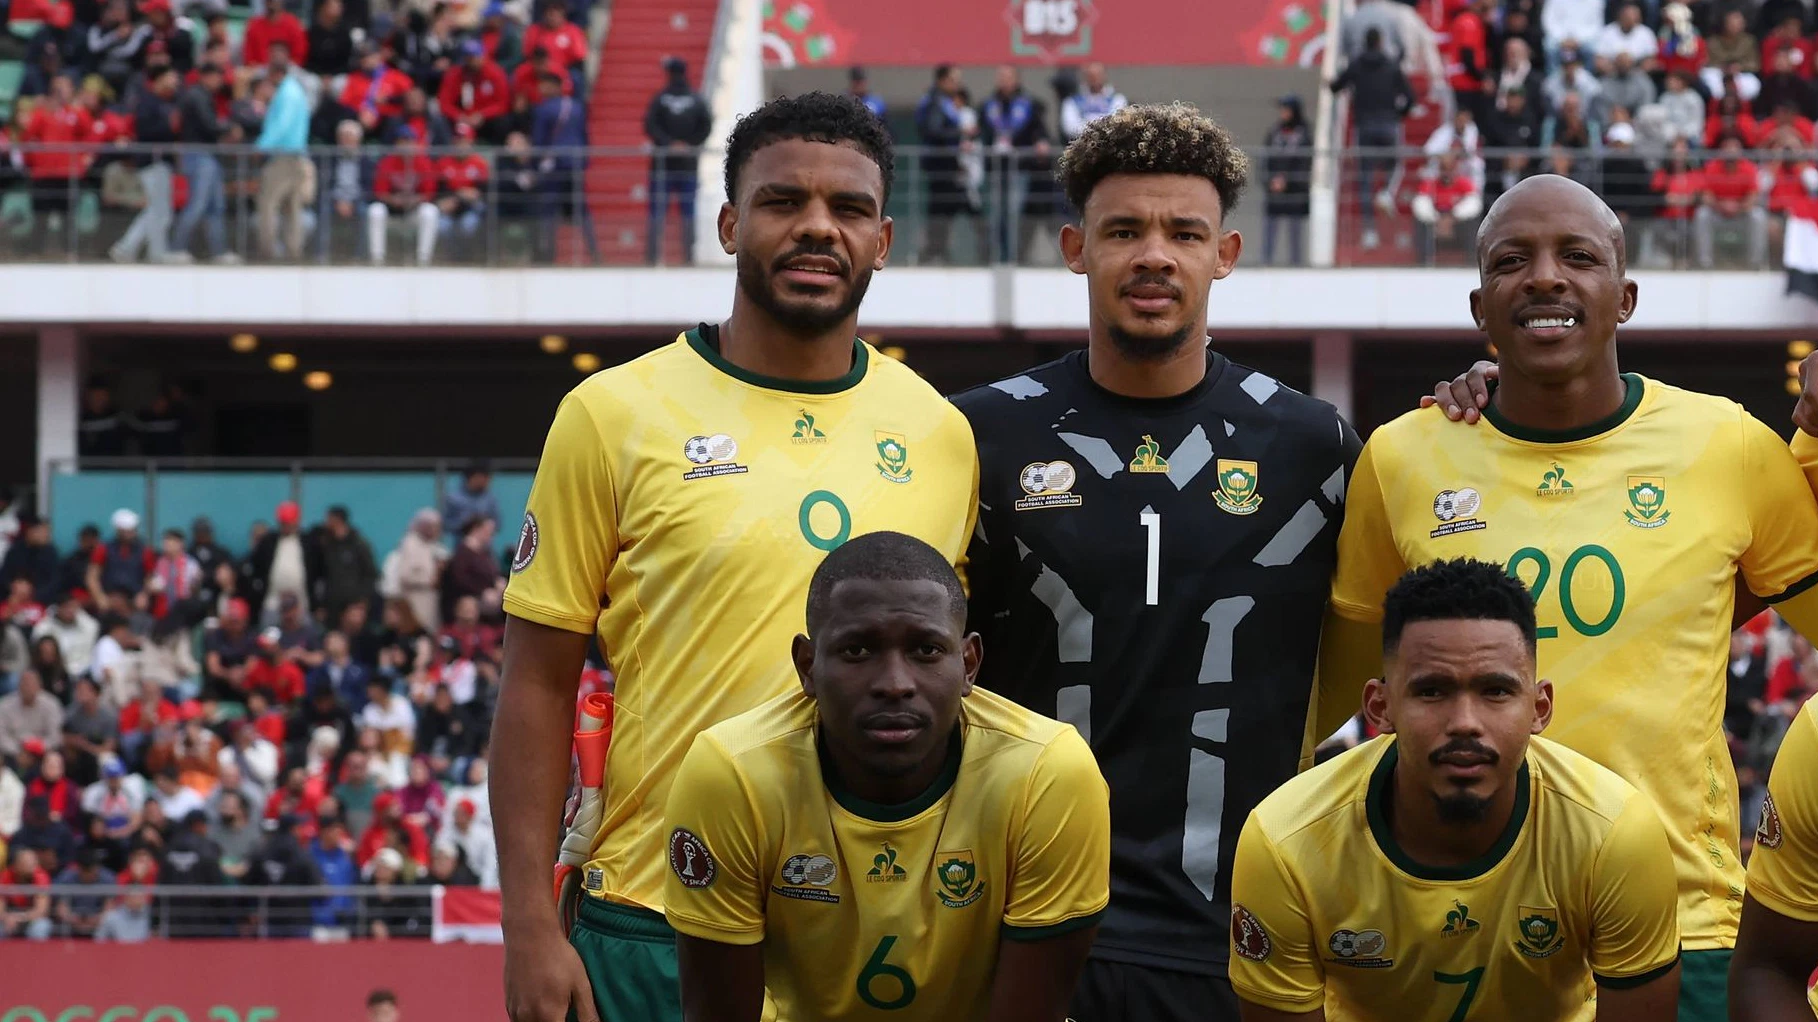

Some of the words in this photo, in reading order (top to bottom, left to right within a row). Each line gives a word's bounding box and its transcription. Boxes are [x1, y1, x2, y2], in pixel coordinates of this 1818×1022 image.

[1023, 0, 1078, 36] B15
[1017, 500, 1044, 508] FOOTBALL
[1140, 513, 1160, 605] 1
[1507, 544, 1625, 639] 20
[856, 935, 917, 1011] 6
